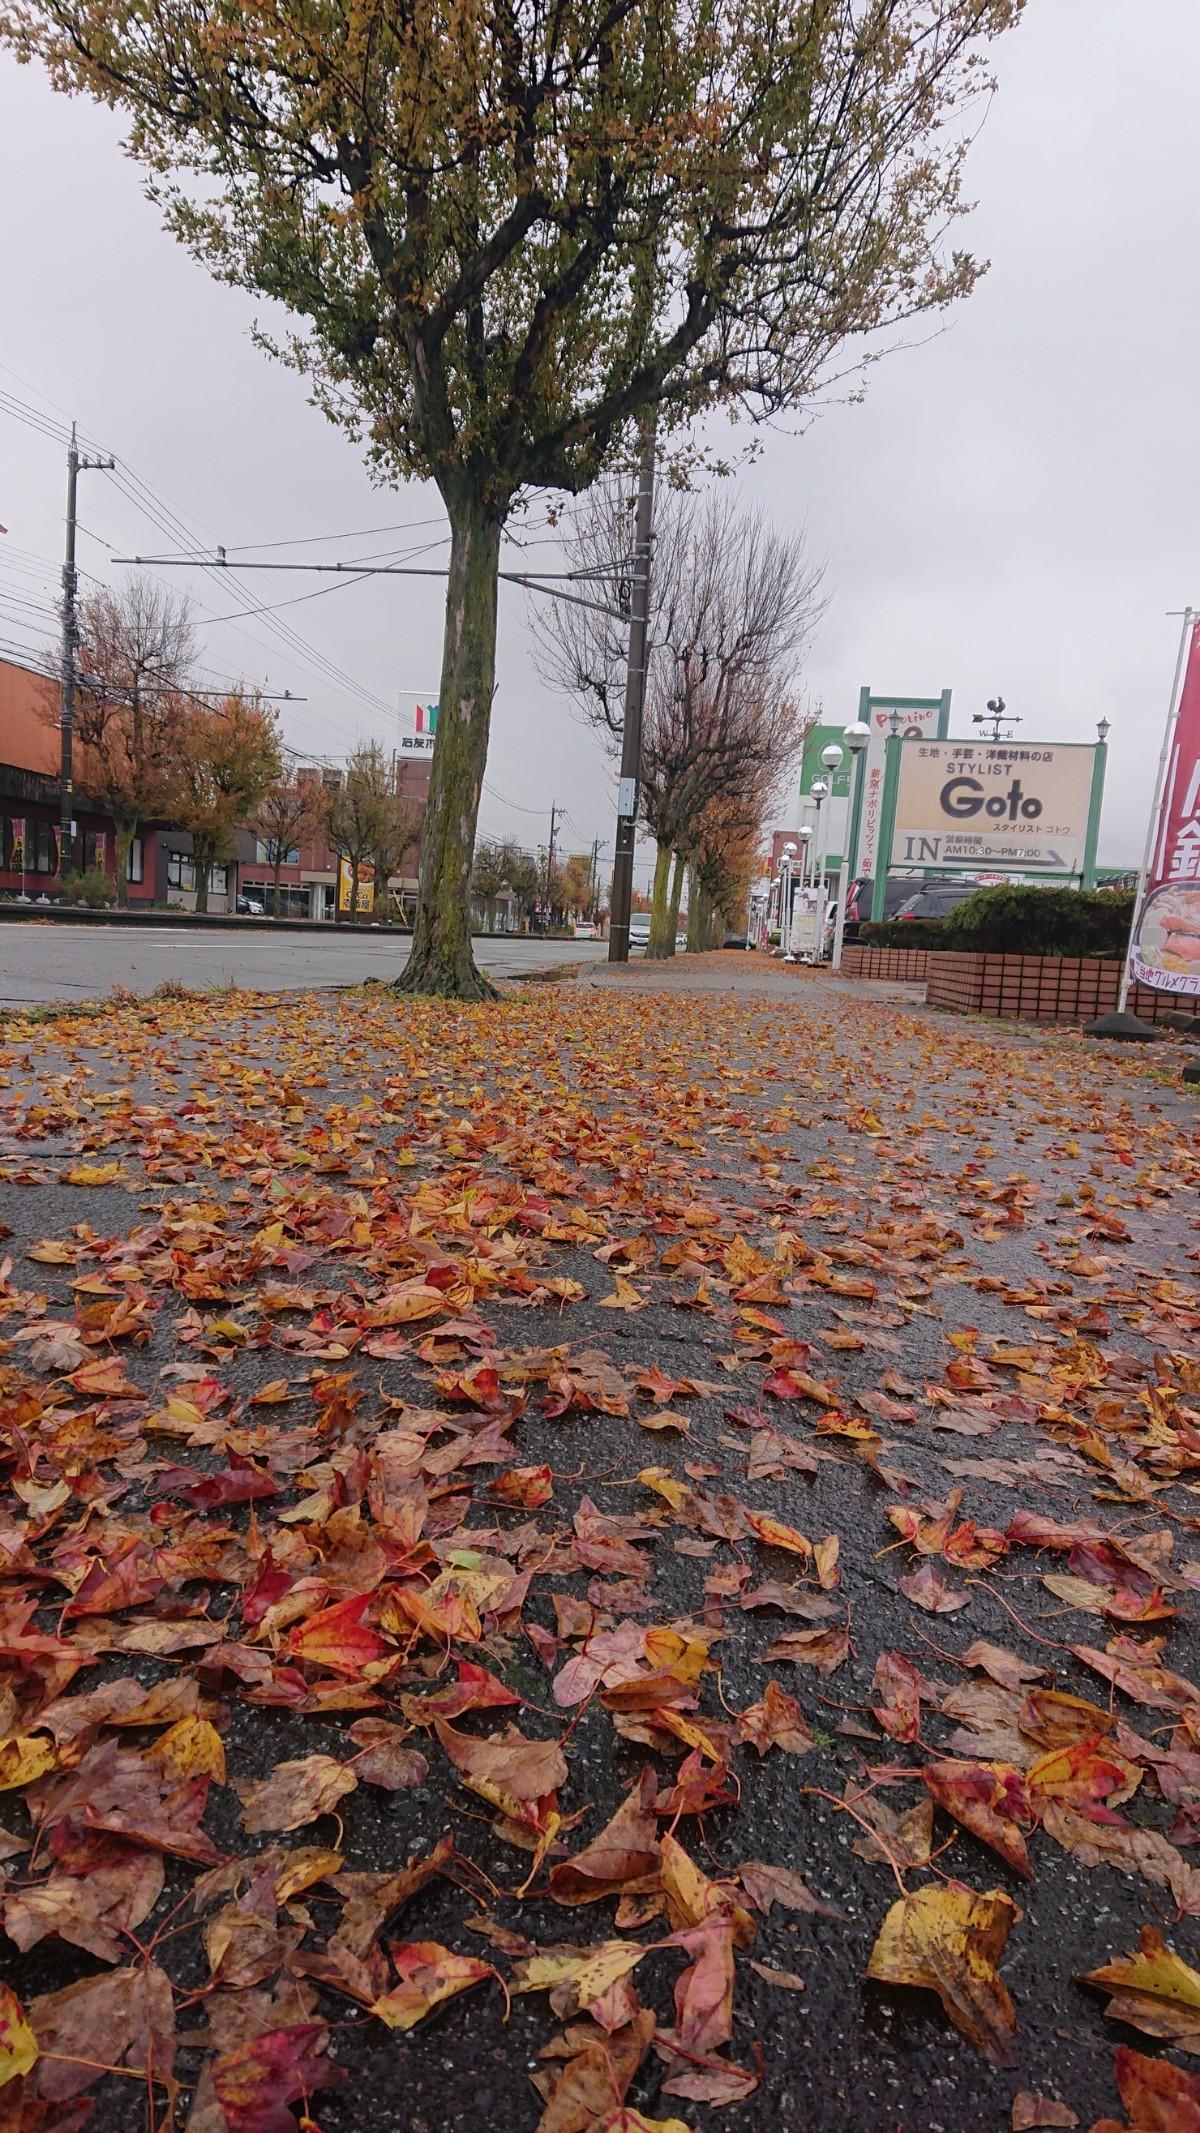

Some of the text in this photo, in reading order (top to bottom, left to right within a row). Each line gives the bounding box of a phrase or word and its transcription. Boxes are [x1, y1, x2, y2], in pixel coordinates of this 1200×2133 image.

[946, 762, 1013, 775] STYLIST
[940, 777, 1043, 821] Goto
[993, 823, 1042, 833] スタイリスト
[904, 836, 942, 861] IN
